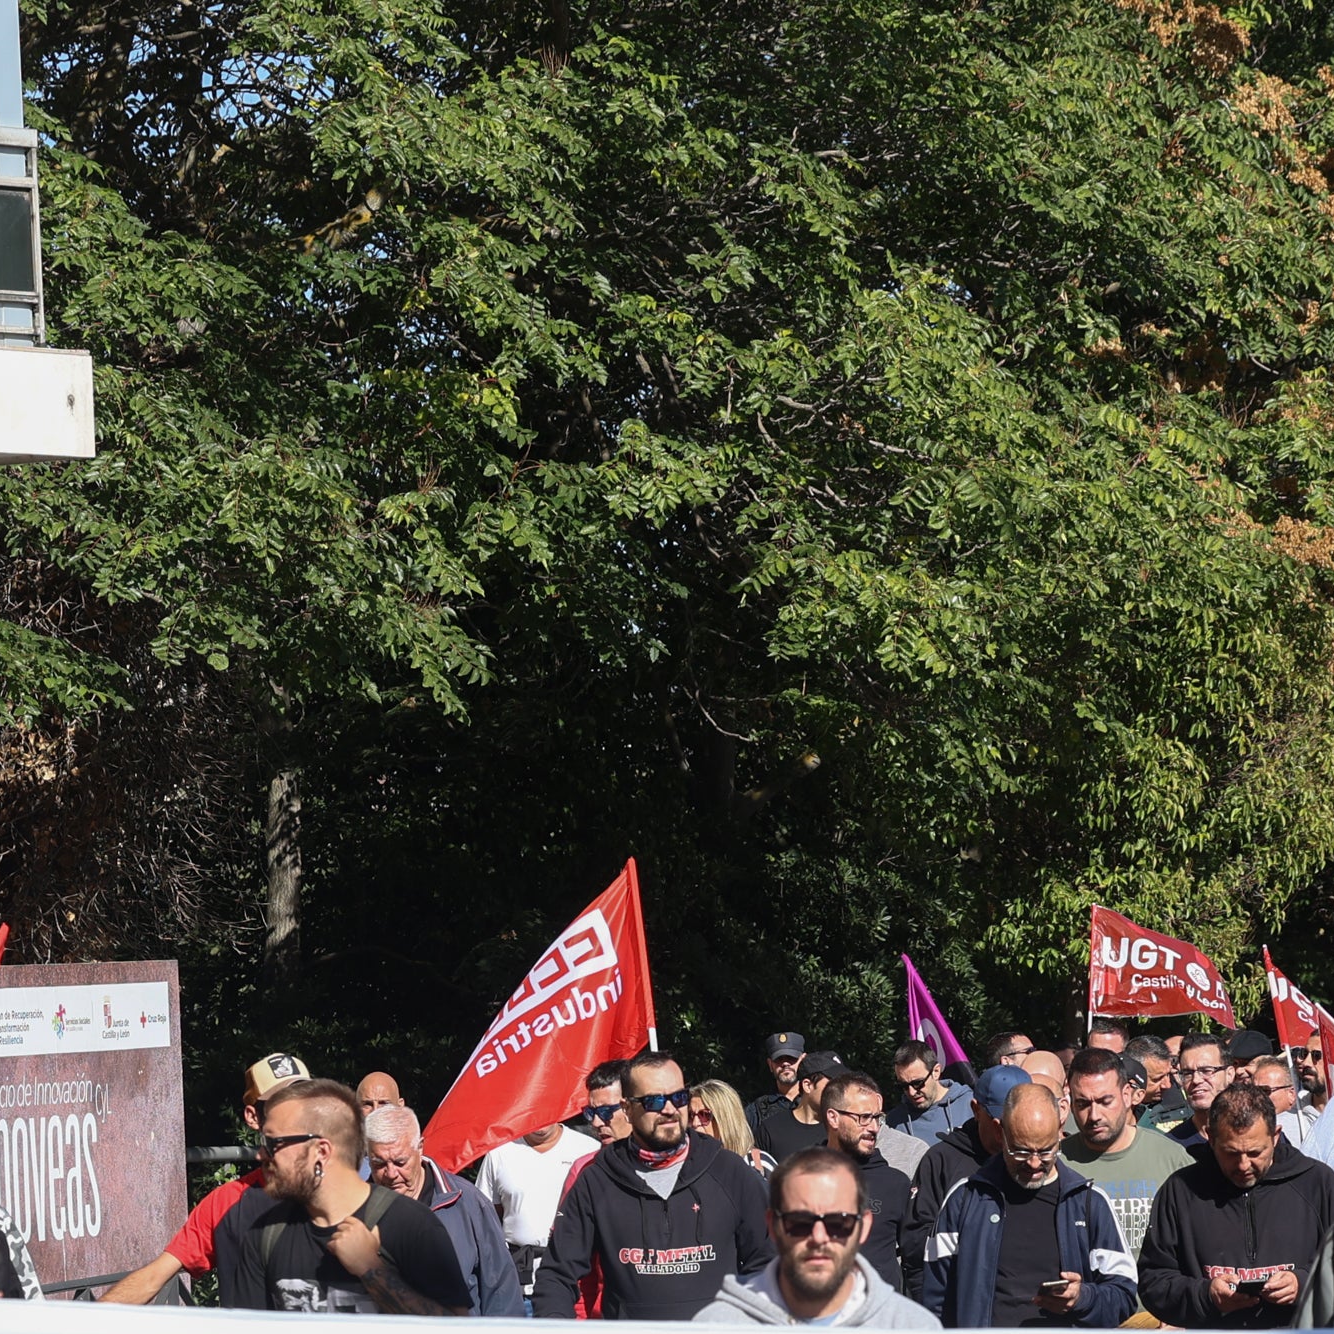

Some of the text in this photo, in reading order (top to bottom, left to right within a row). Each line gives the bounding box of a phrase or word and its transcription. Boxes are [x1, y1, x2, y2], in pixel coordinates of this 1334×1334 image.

[1101, 936, 1181, 971] UGT
[1131, 973, 1185, 989] Castilla
[1196, 990, 1227, 1011] León
[4, 1010, 11, 1019] de
[0, 1035, 24, 1046] Resiliencia
[17, 1075, 32, 1107] de
[34, 1073, 93, 1106] Innovación
[95, 1083, 112, 1123] CyL
[619, 1244, 716, 1265] CGT METAL
[635, 1263, 701, 1275] VALLADOLID
